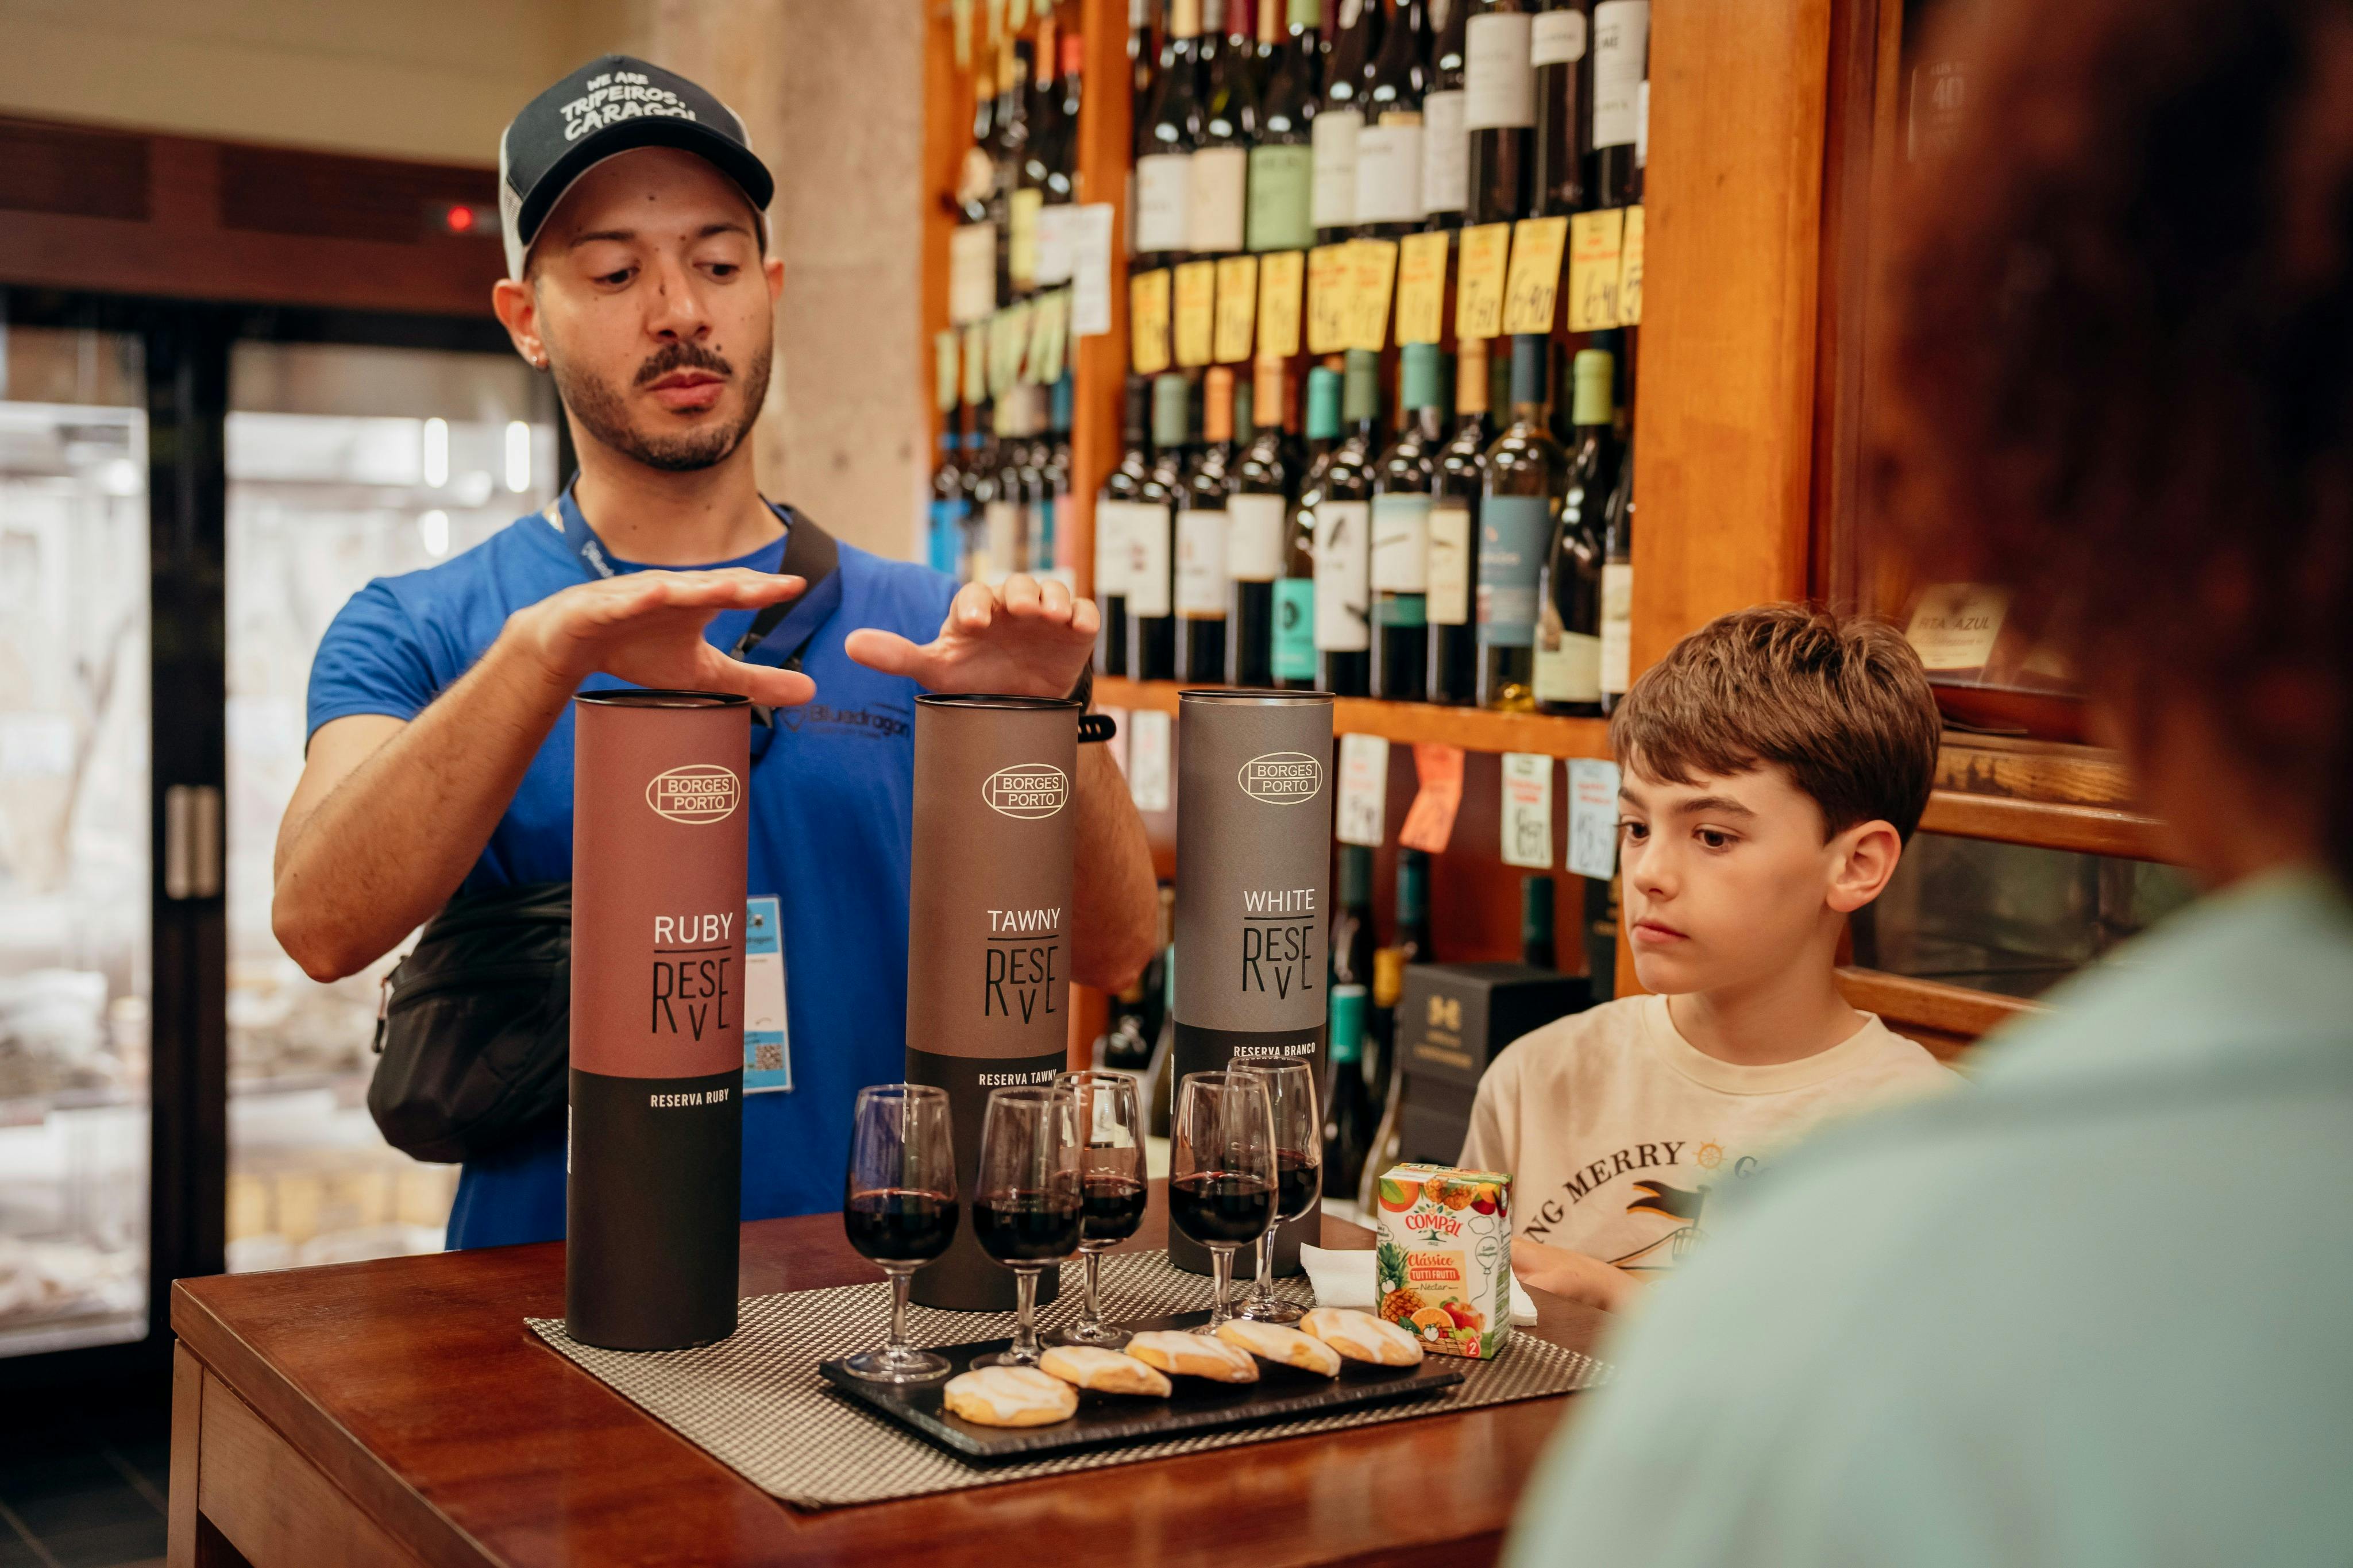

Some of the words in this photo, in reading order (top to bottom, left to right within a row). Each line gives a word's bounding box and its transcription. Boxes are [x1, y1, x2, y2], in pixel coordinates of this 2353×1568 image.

[587, 74, 612, 91] WE
[615, 71, 649, 85] ARE
[1954, 616, 1989, 630] AZUL
[1257, 764, 1312, 777] BORGES
[668, 779, 730, 793] BORGES
[1003, 777, 1059, 790] BORGES
[1263, 780, 1309, 792] PORTO
[674, 796, 725, 810] PORTO
[1008, 793, 1055, 806] PORTO
[1244, 889, 1315, 912] WHITE
[987, 907, 1060, 932] TAWNY
[654, 912, 733, 944] RUBY
[1234, 1046, 1280, 1057] RESERVA
[1284, 1042, 1316, 1056] BRANCO
[979, 1073, 1027, 1086] RESERVA
[1031, 1069, 1058, 1084] TAWNY
[650, 1092, 703, 1107] RESERVA
[706, 1088, 730, 1104] RUBY
[1523, 1199, 1565, 1244] NG
[1563, 1141, 1685, 1204] MERRY
[1408, 1253, 1454, 1266] Clássico
[1411, 1270, 1432, 1280] TUTTI
[1433, 1270, 1456, 1279] FRUTTI
[1468, 1342, 1476, 1355] 2
